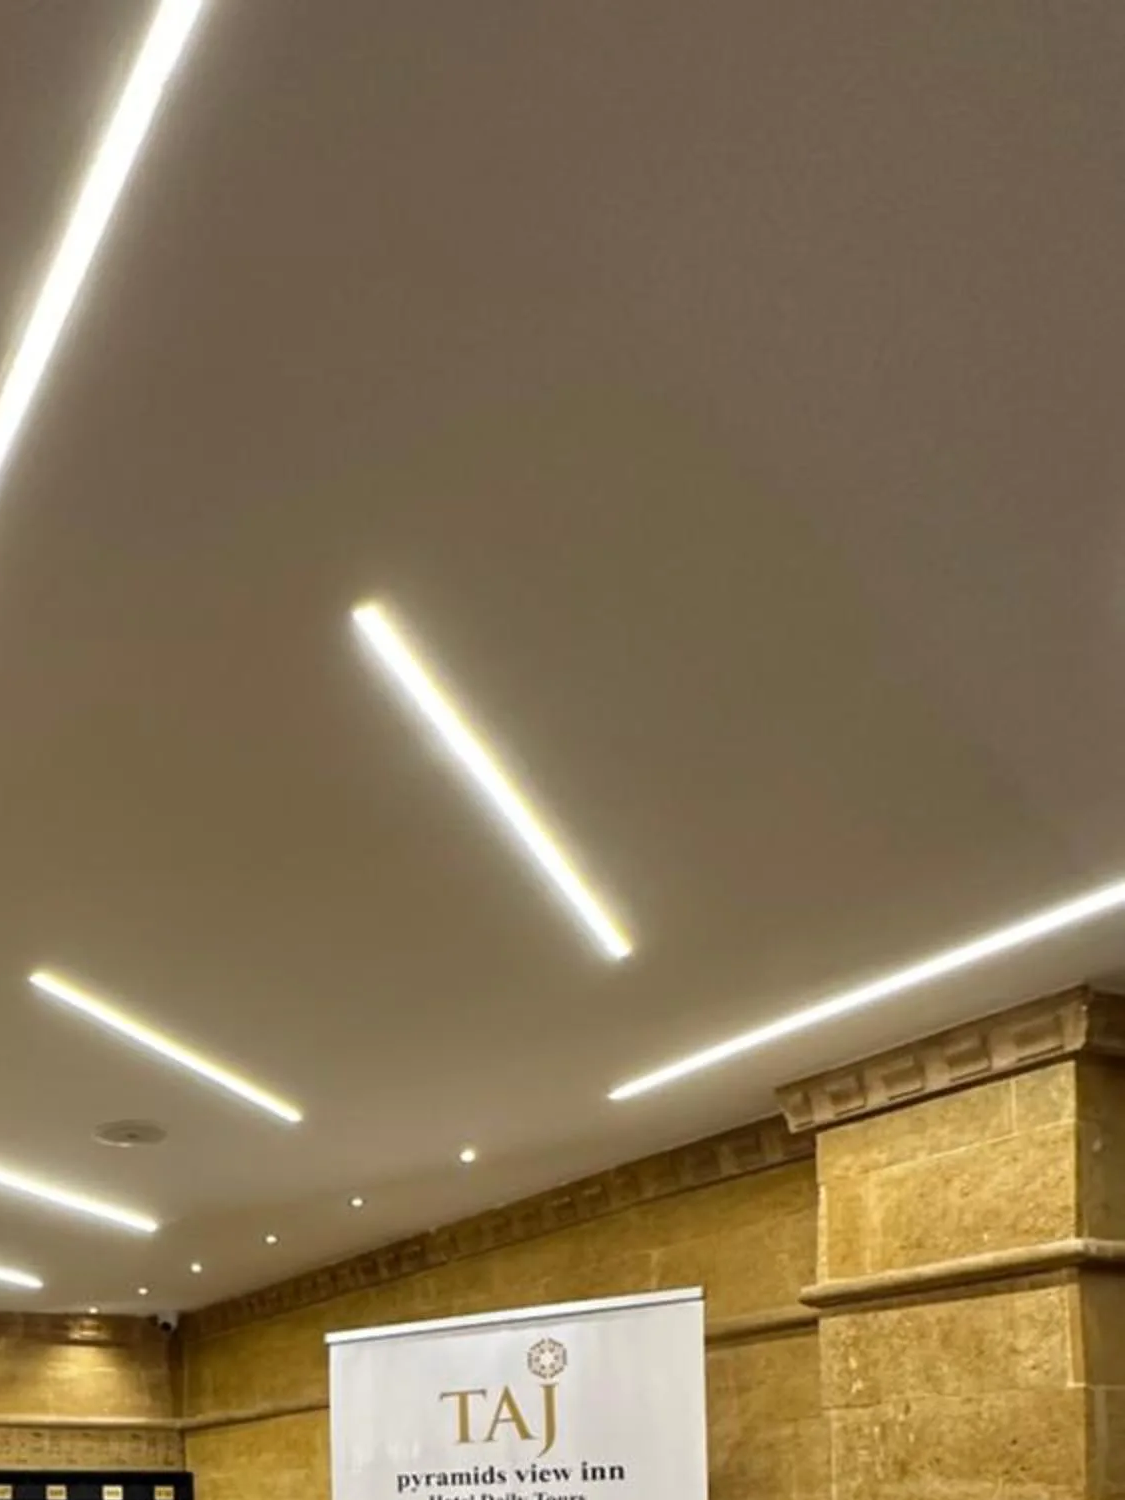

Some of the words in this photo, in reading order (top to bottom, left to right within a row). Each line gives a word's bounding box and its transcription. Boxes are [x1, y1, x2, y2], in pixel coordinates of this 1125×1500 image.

[438, 1383, 559, 1458] TAJ
[397, 1465, 507, 1493] pyramids
[515, 1464, 572, 1484] view
[581, 1461, 625, 1482] inn
